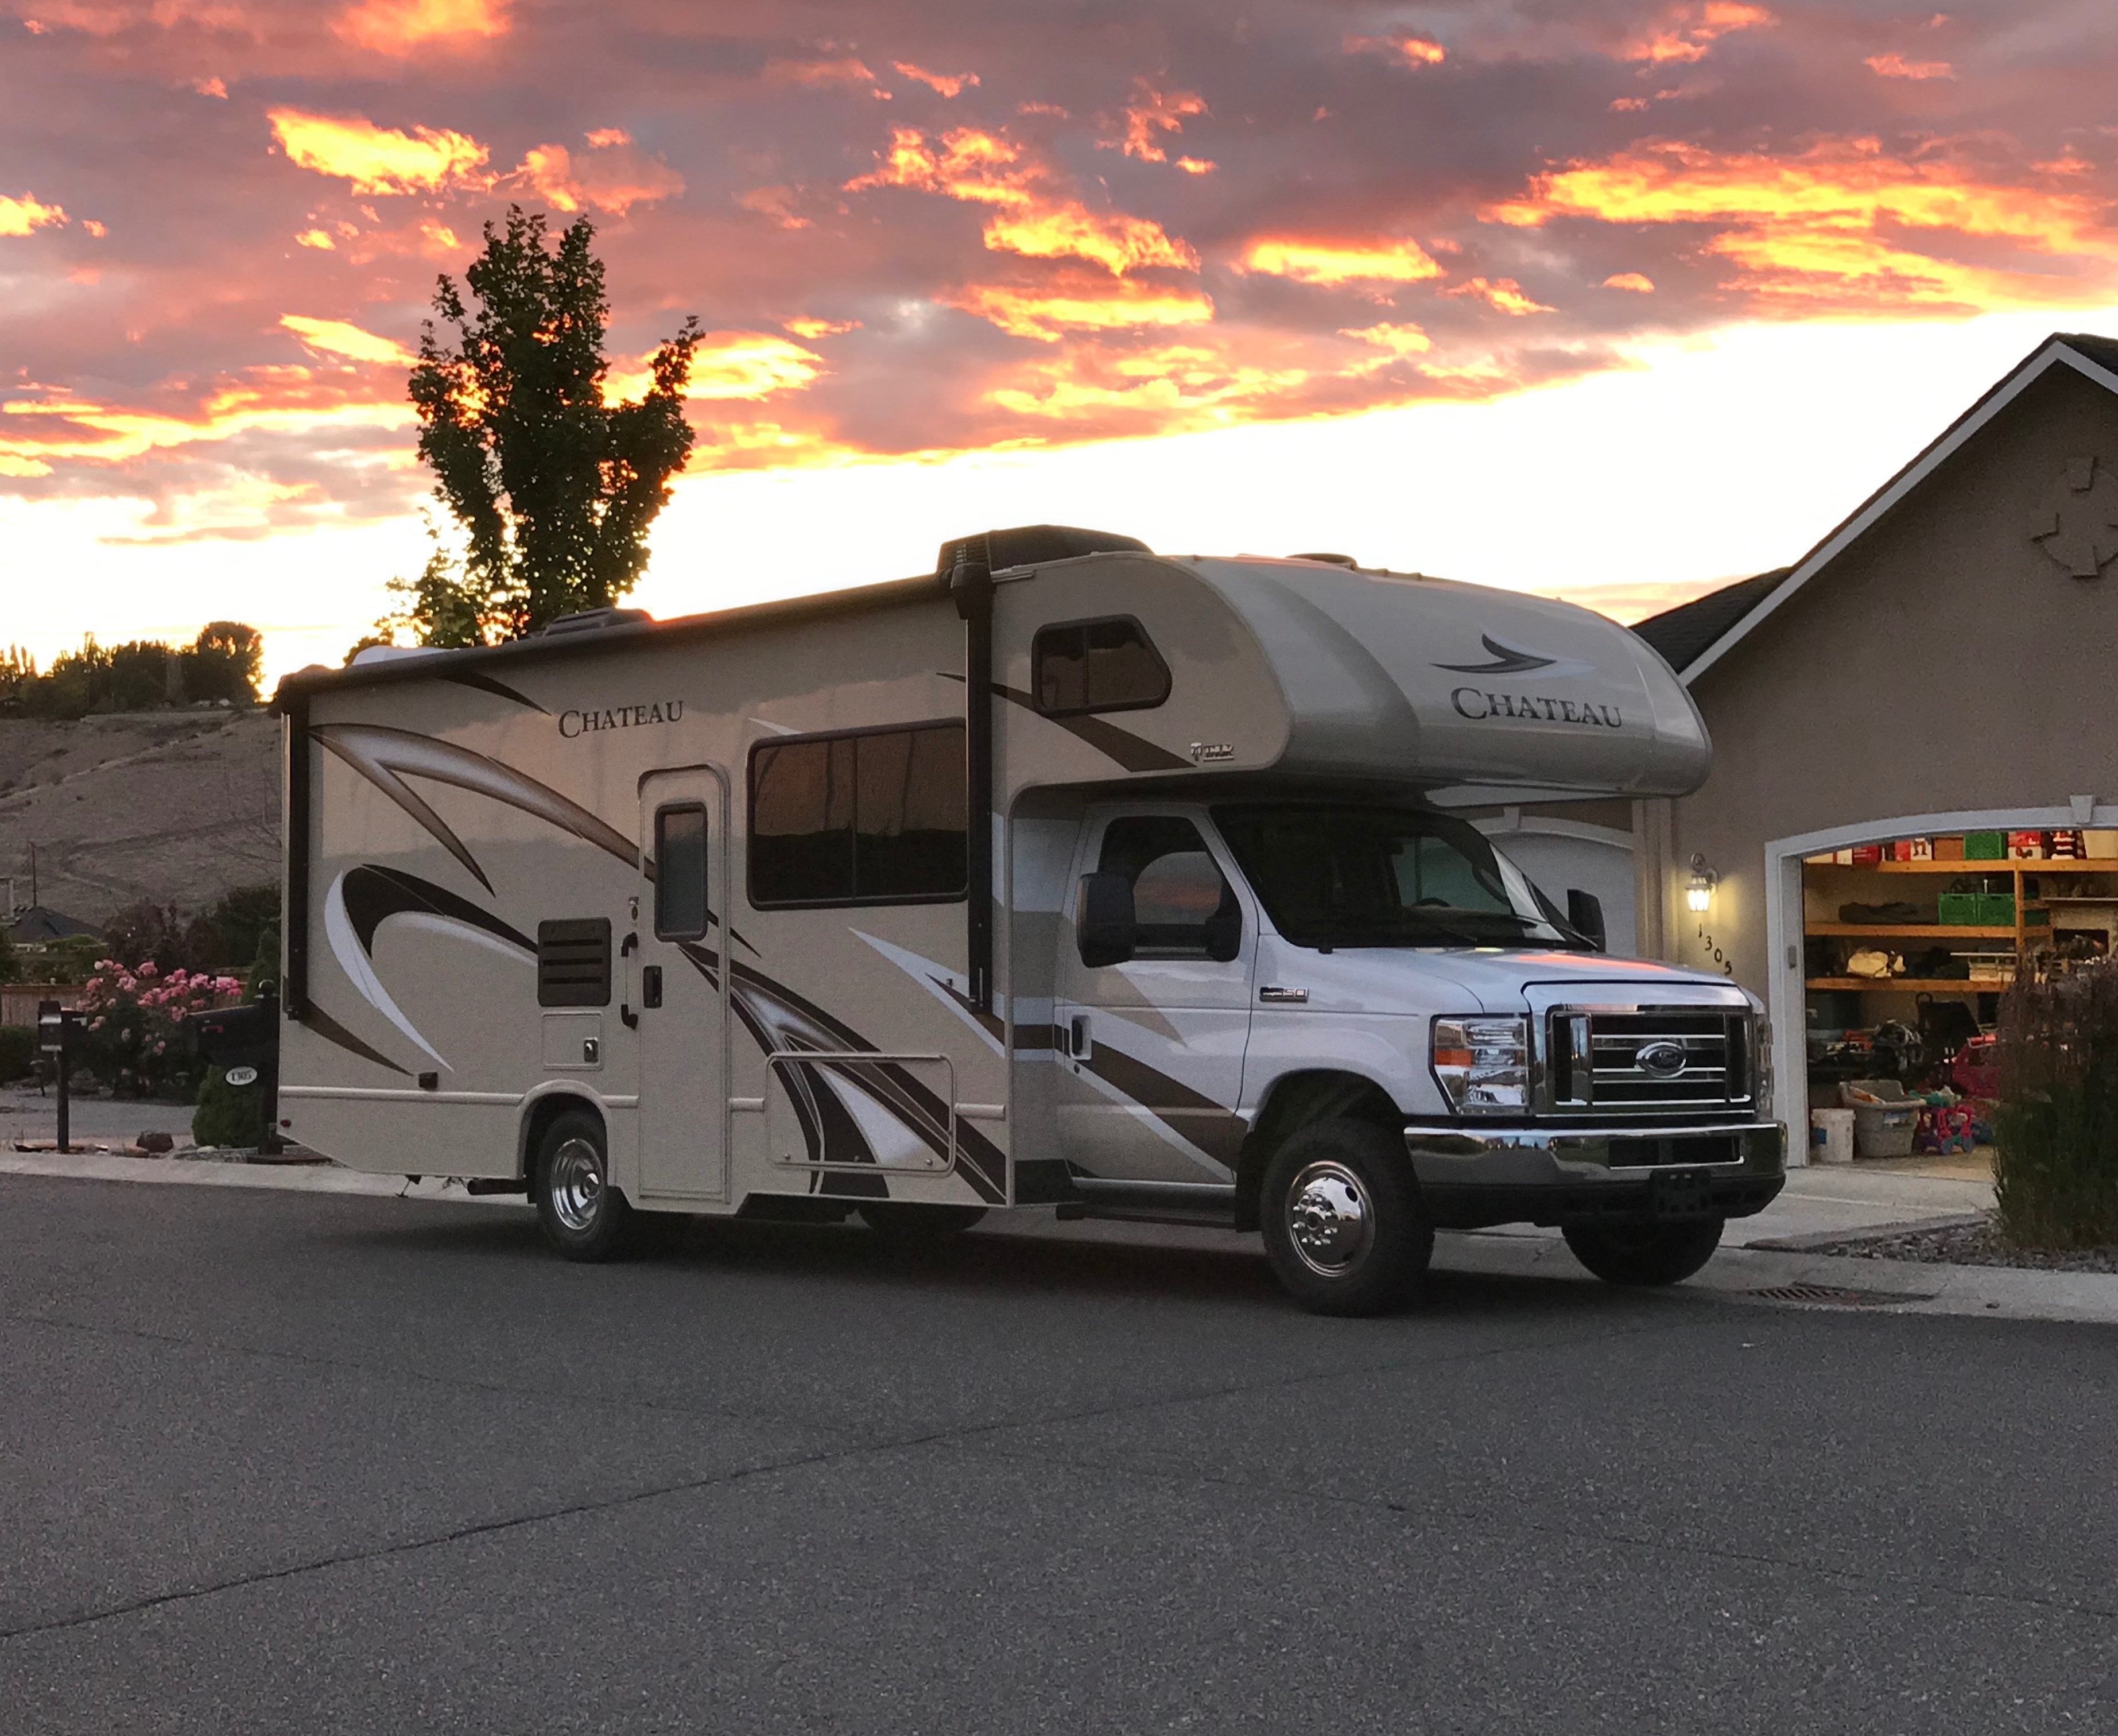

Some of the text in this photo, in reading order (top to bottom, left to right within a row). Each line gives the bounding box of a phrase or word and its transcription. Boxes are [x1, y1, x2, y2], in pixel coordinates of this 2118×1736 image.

[558, 700, 684, 738] CHATEAU
[1450, 687, 1622, 727] CHATEAU
[1698, 923, 1732, 976] 1305
